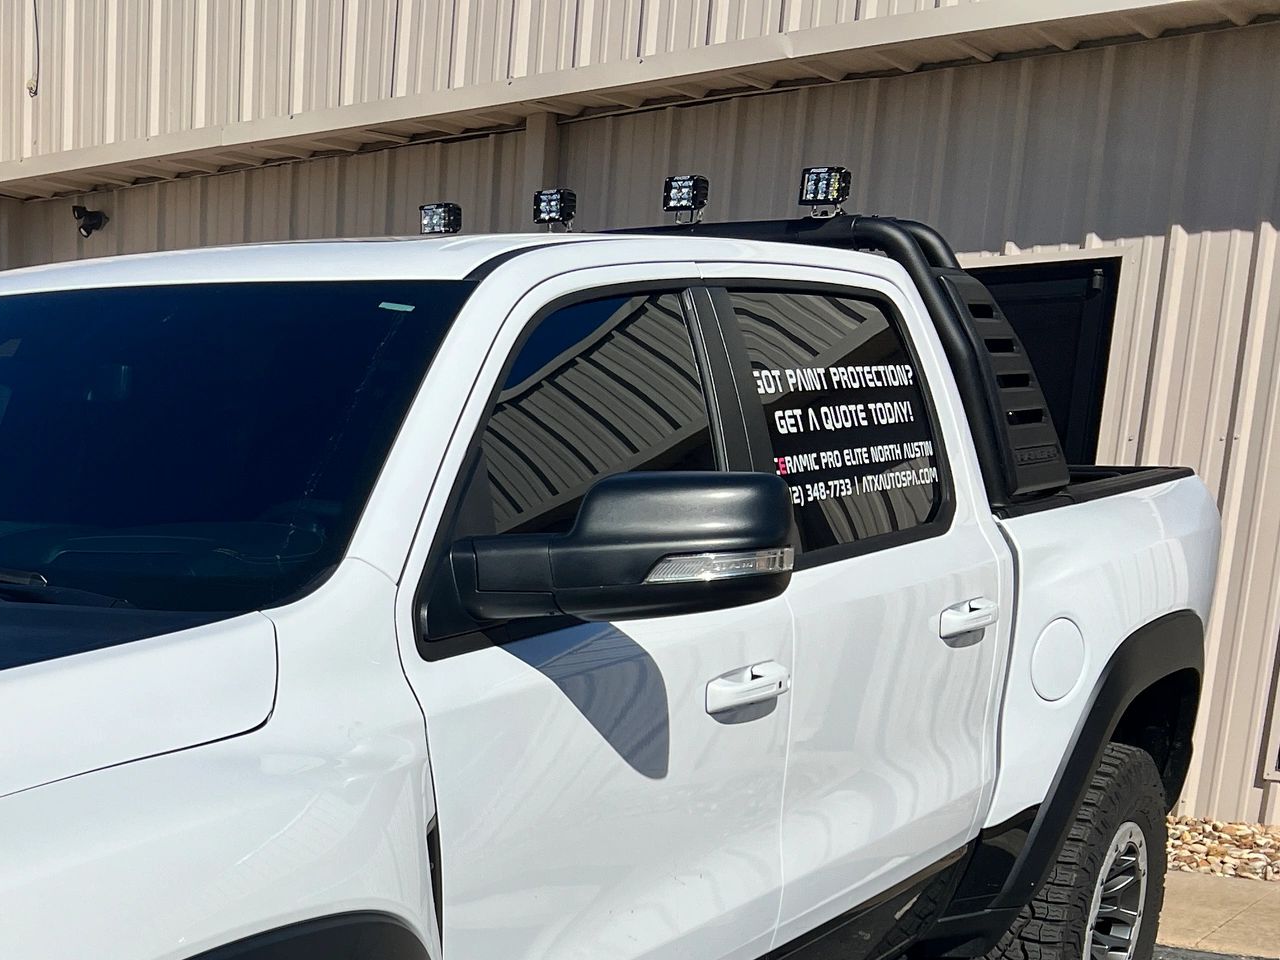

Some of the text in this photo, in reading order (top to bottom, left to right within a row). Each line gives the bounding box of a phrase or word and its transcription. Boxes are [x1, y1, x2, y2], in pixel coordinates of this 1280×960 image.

[785, 367, 828, 392] PAINT
[829, 365, 914, 389] PROTECTION?
[774, 401, 915, 434] GET A QUOTE TODAY!
[820, 450, 842, 468] PRO
[844, 447, 870, 467] ELITE
[870, 444, 902, 463] NORTH
[903, 441, 934, 459] AUSTIN
[807, 478, 853, 501] 348-7733
[862, 467, 939, 494] ATXAUTOSPA.COM
